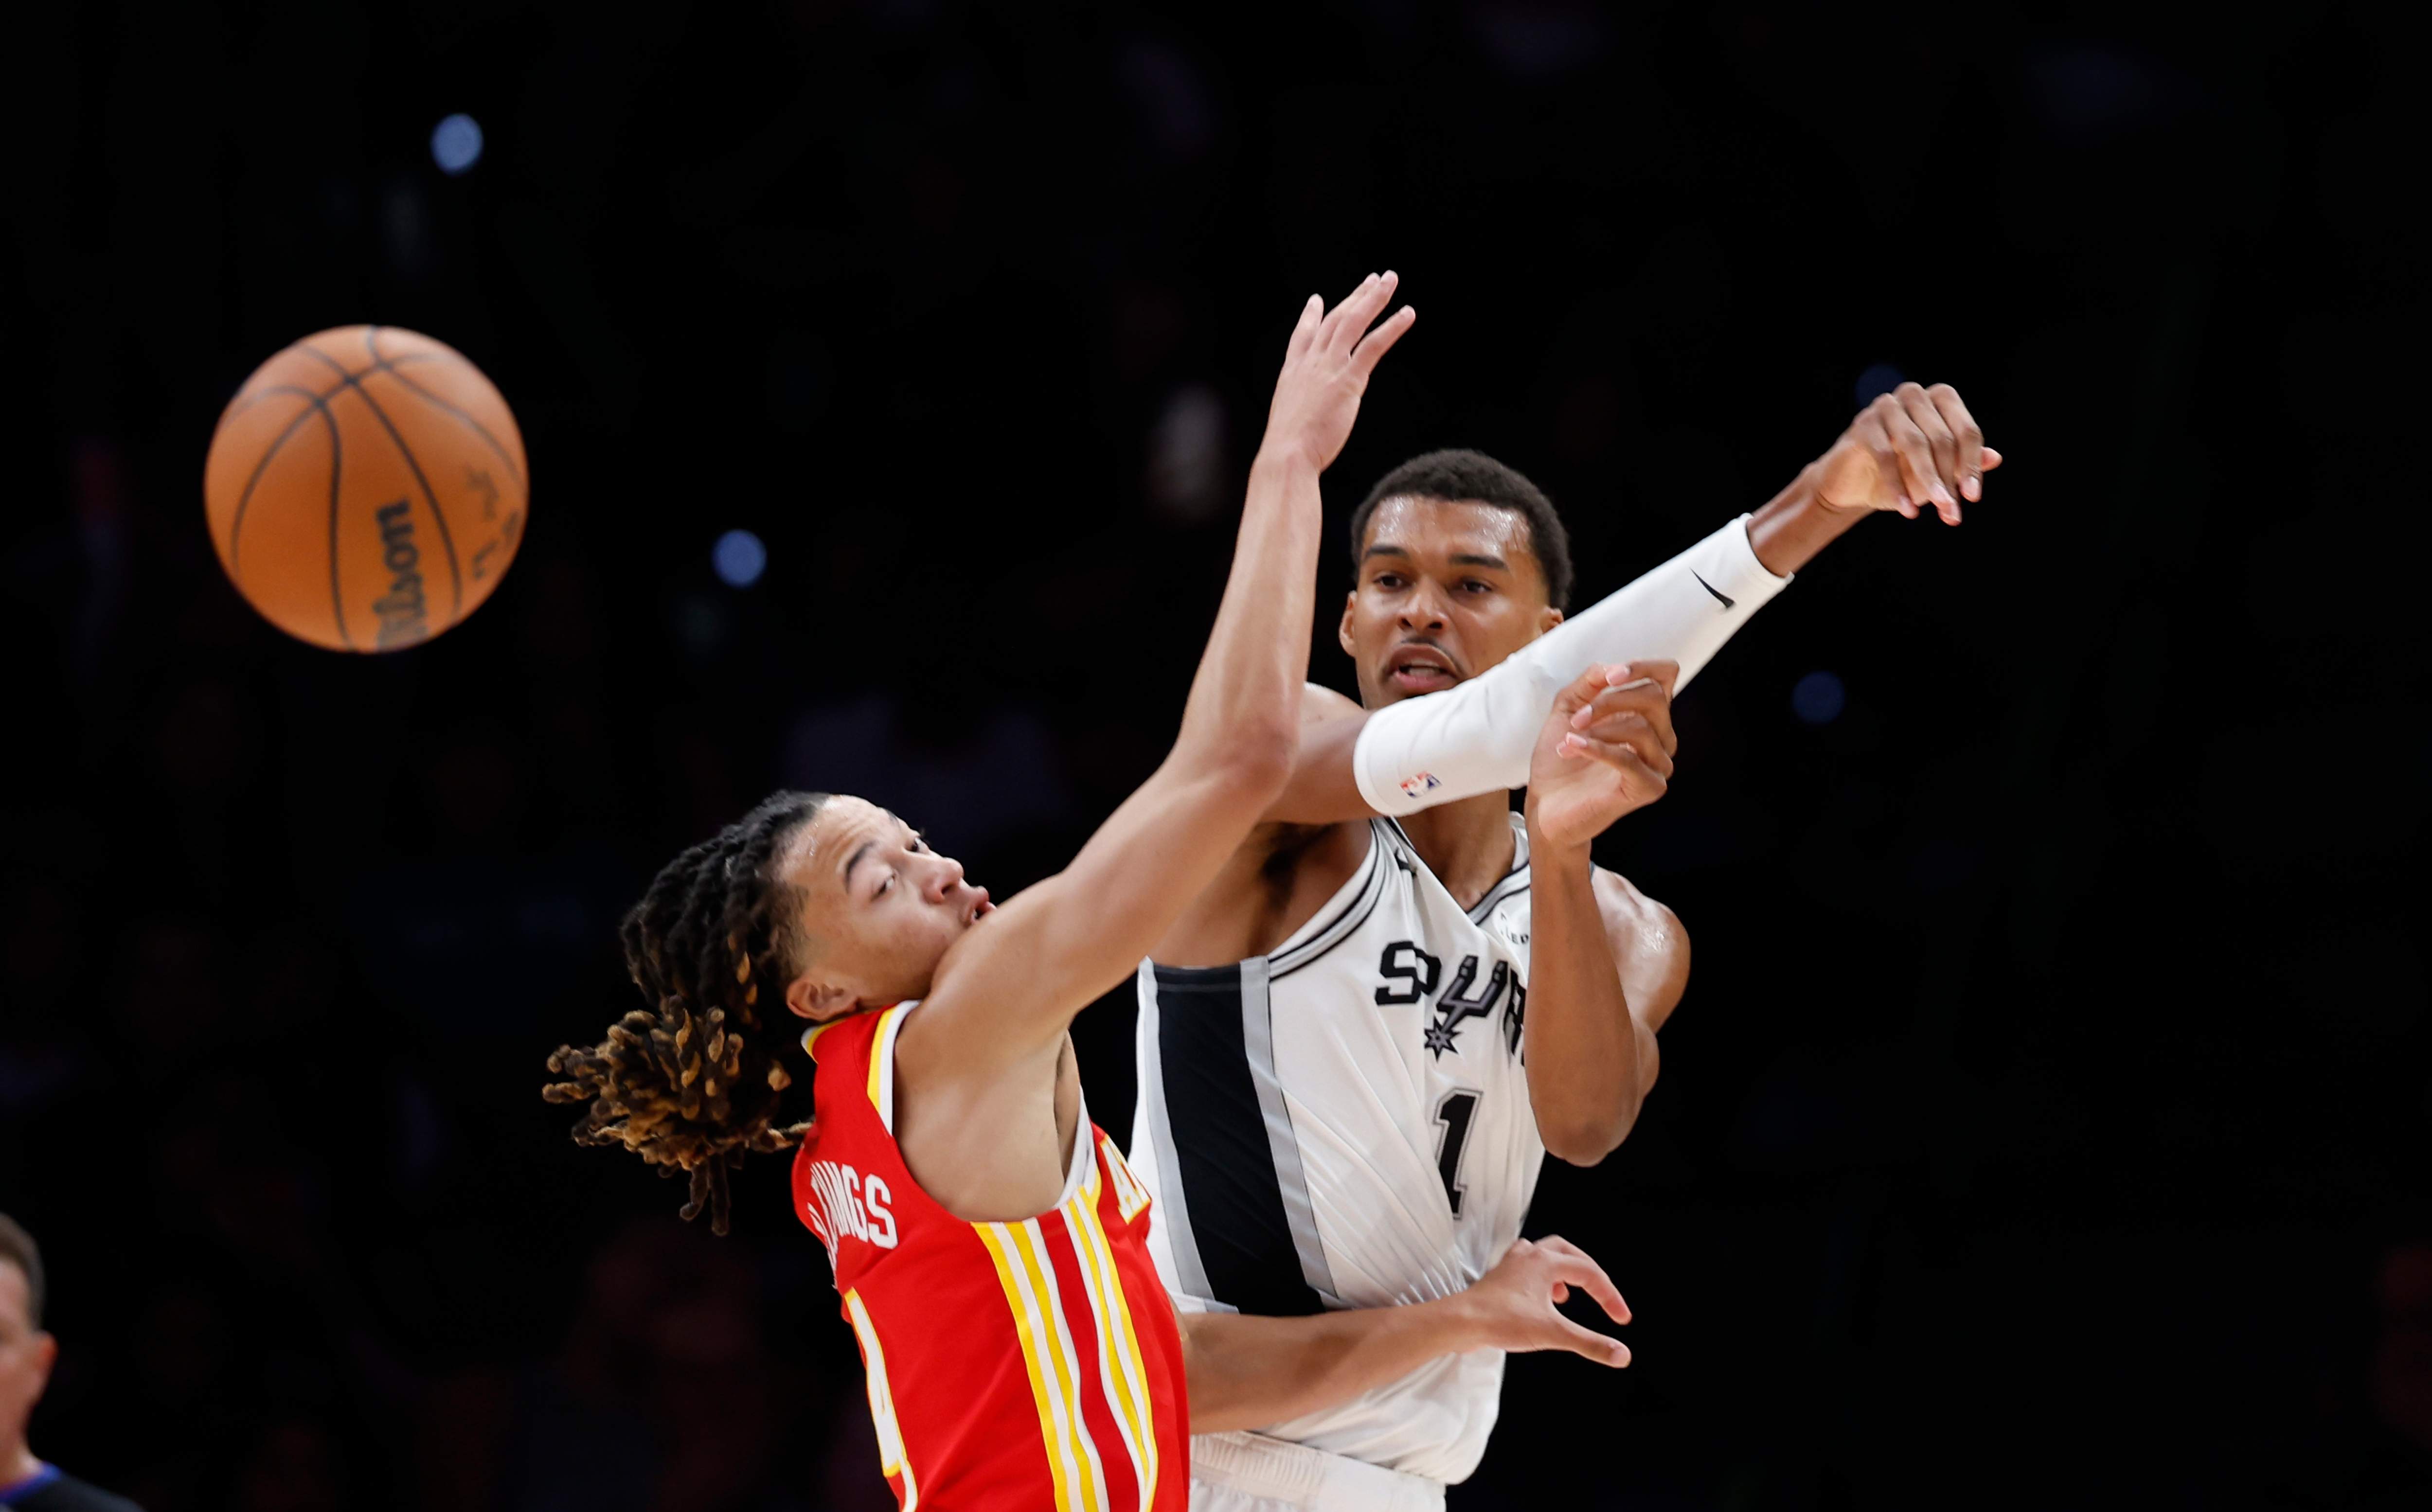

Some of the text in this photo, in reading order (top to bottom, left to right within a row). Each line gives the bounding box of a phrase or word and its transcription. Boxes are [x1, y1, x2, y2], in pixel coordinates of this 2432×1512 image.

[373, 496, 428, 651] ilson
[1375, 941, 1526, 1065] SPUR
[1433, 1086, 1483, 1220] 1
